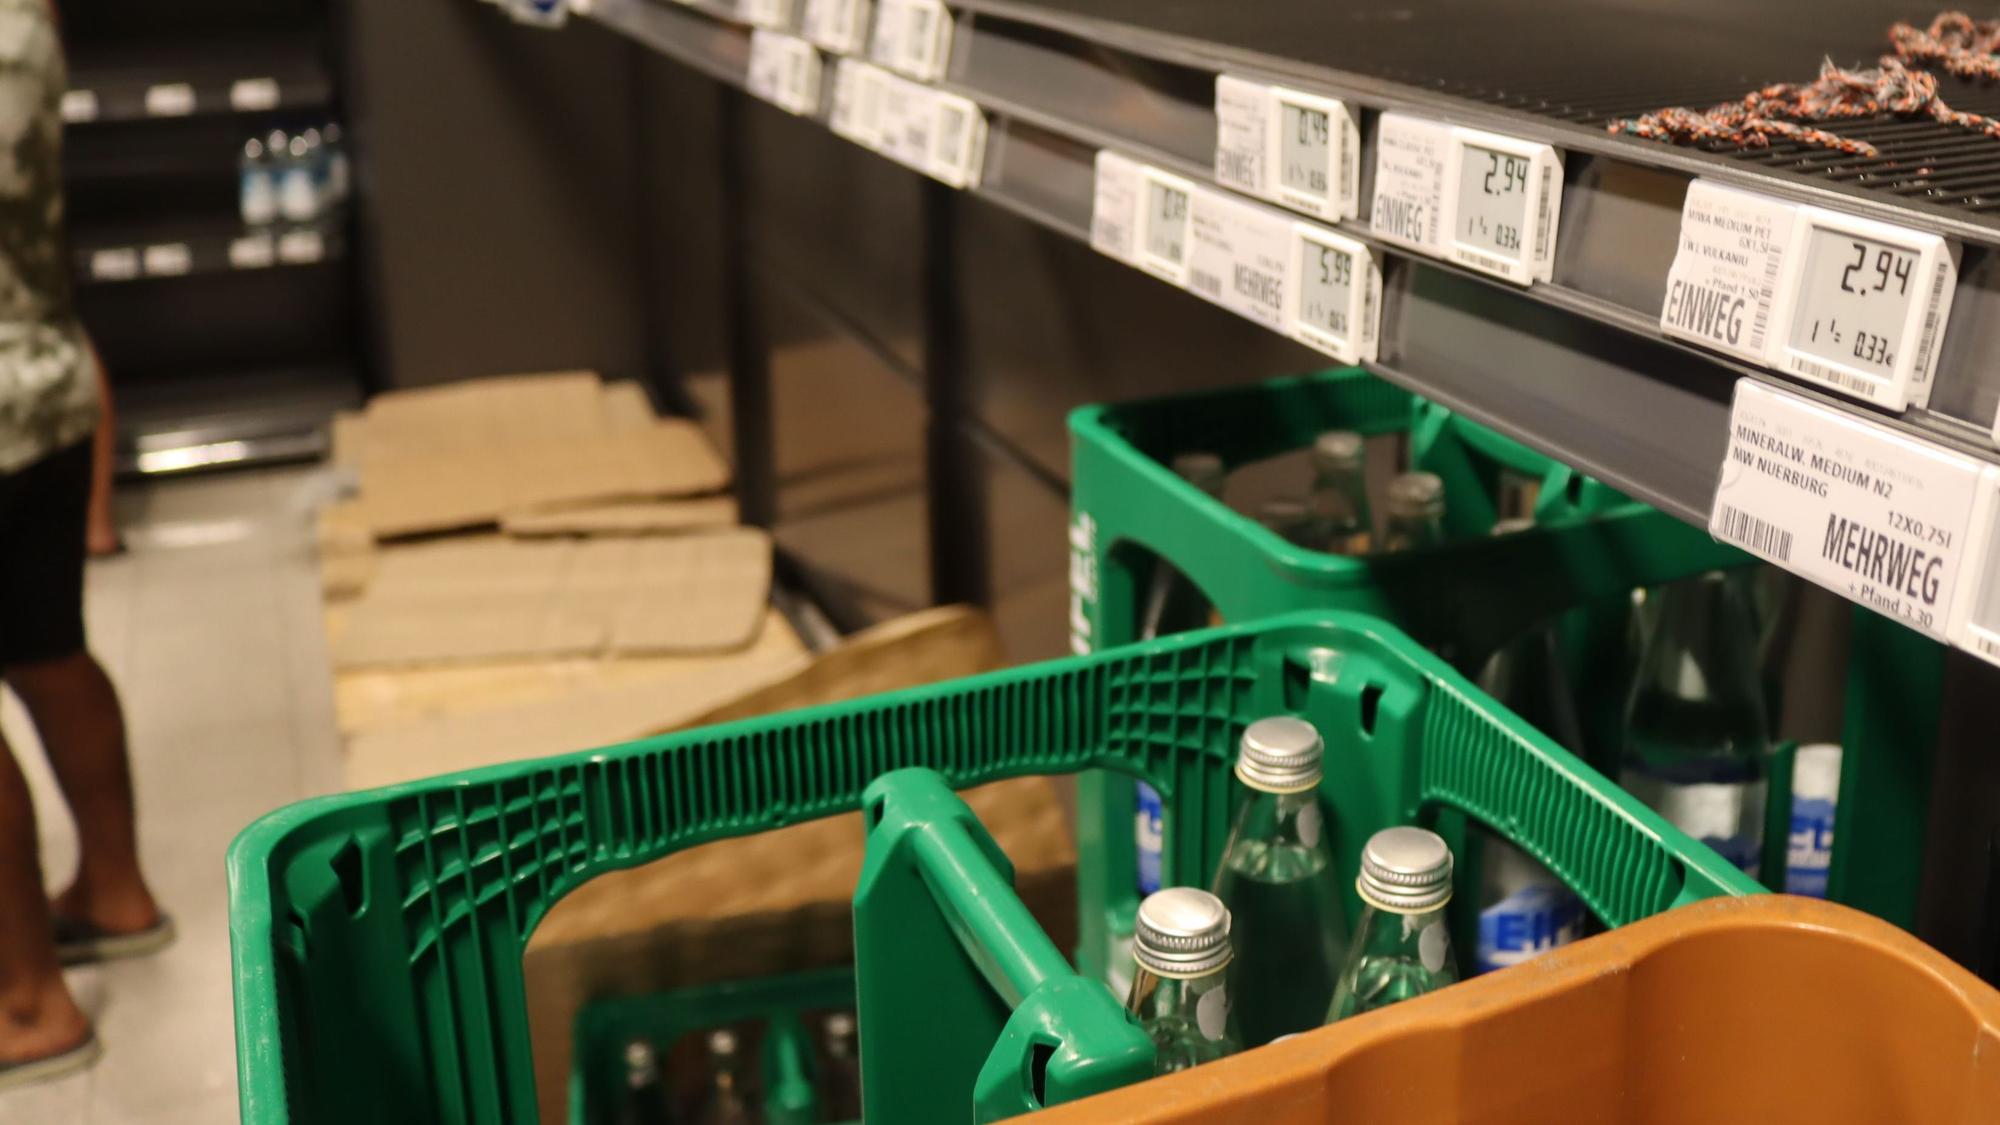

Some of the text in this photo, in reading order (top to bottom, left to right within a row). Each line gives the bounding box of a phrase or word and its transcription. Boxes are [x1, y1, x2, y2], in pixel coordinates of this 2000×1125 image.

[1485, 153, 1528, 196] 2.94
[1375, 193, 1424, 243] EINWEG
[1713, 215, 1752, 235] MEDIUM
[1754, 224, 1771, 240] PET
[1712, 277, 1738, 295] Pfand
[1841, 242, 1912, 297] 2.94
[1666, 279, 1745, 345] EINWEG
[1732, 446, 1755, 466] MW
[1757, 456, 1829, 498] NUERBURG
[1736, 423, 1806, 465] MINERALW.
[1810, 453, 1871, 491] MEDIUM
[1873, 477, 1893, 500] N2
[1821, 512, 1943, 606] MEHRWEG
[1861, 583, 1901, 615] Pfand
